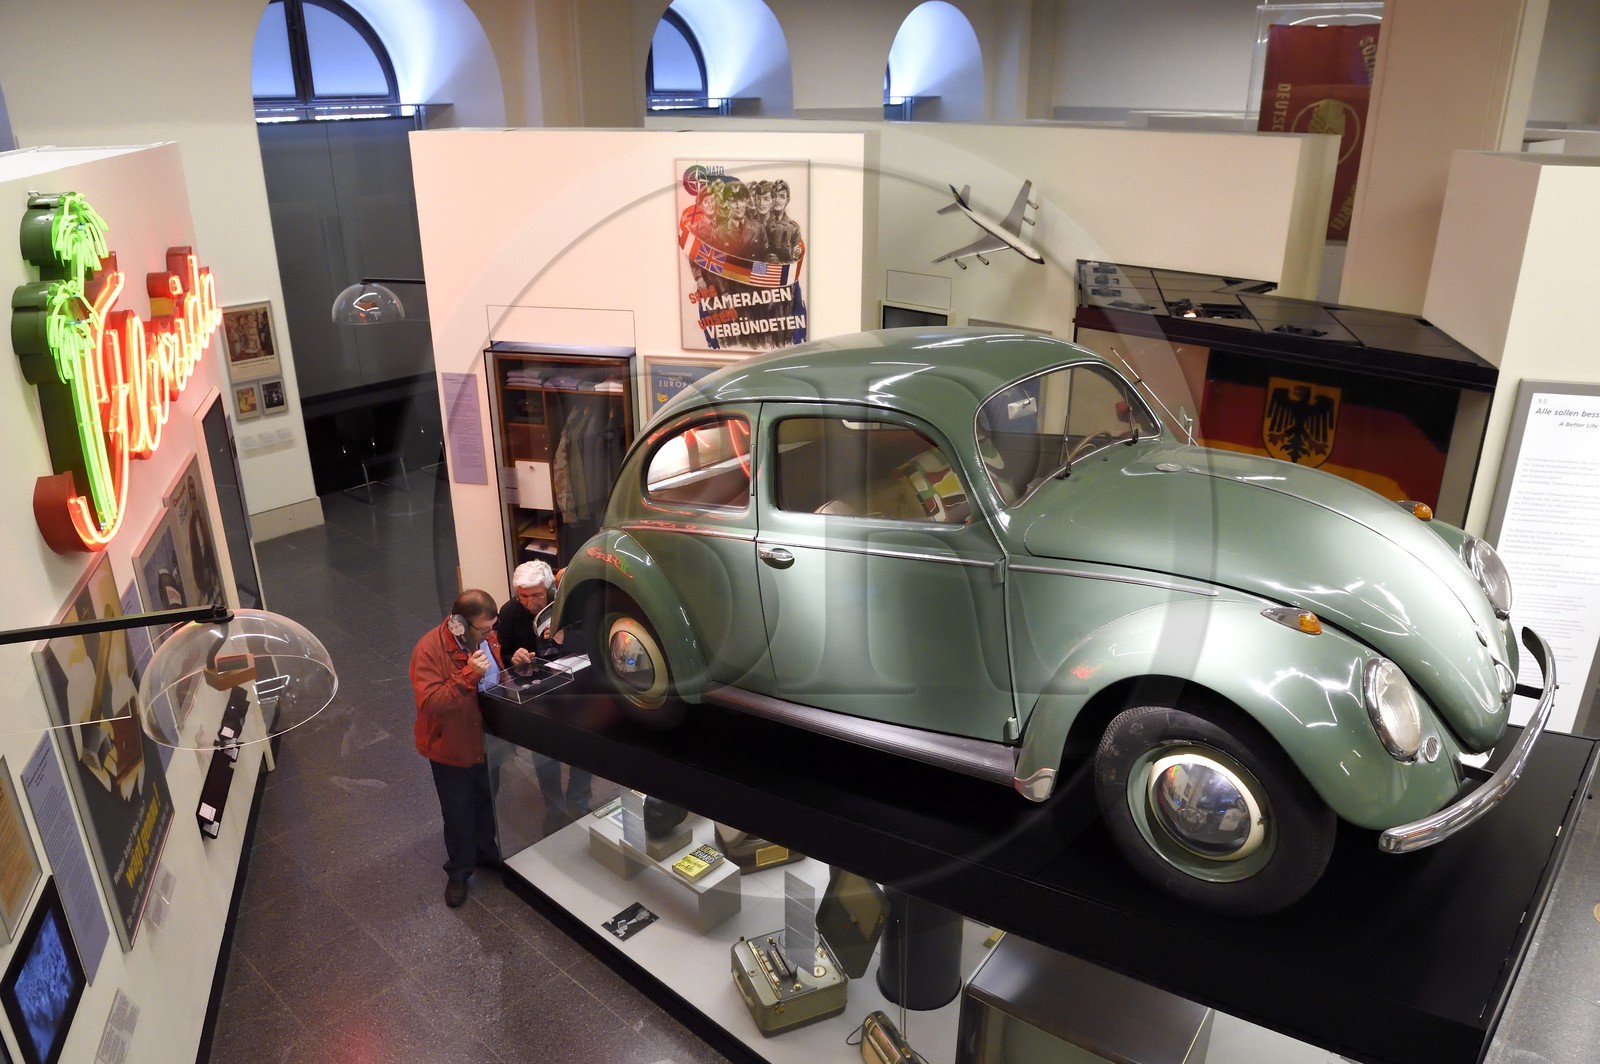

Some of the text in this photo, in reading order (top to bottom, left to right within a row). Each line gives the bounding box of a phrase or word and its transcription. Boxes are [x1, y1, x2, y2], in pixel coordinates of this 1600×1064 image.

[706, 165, 725, 176] NATO
[701, 288, 792, 311] KAMERADEN
[705, 315, 806, 339] VERBÜNDETEN
[659, 380, 691, 388] EUROP
[1535, 407, 1552, 416] Alle
[1554, 409, 1579, 417] sollen
